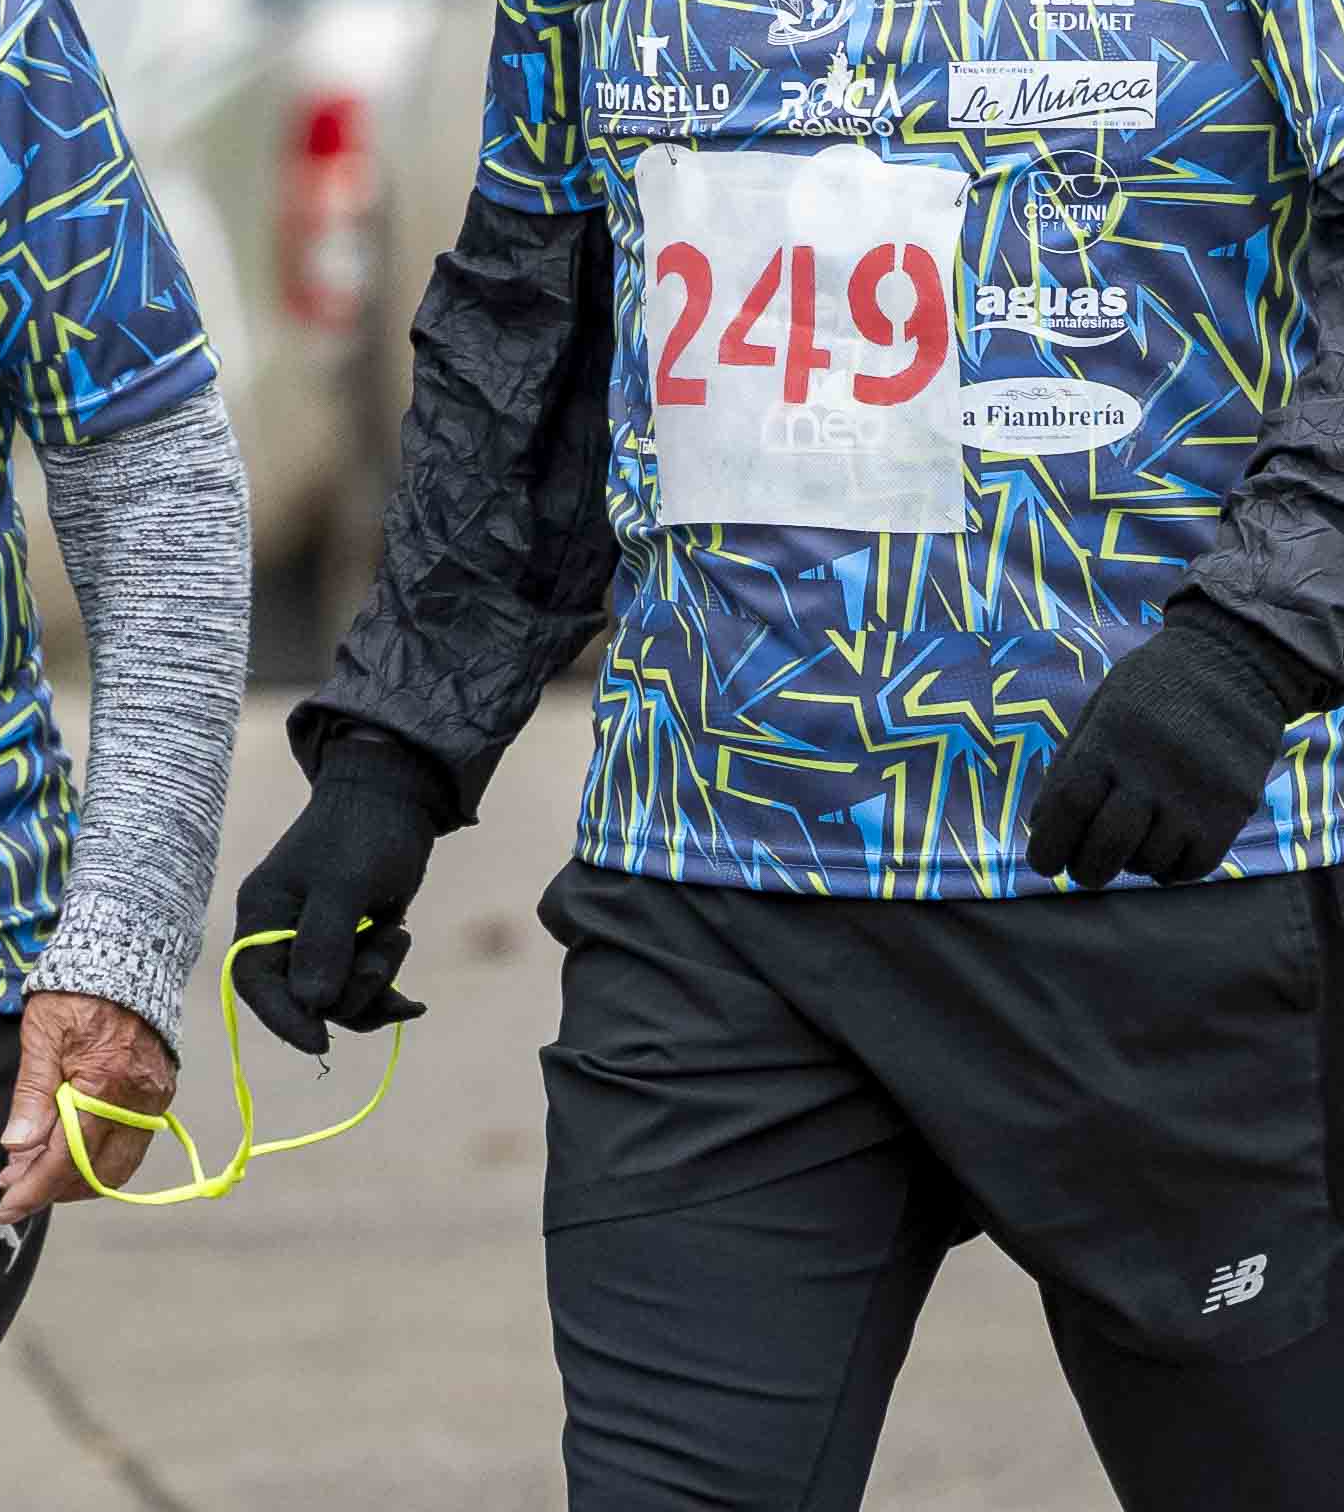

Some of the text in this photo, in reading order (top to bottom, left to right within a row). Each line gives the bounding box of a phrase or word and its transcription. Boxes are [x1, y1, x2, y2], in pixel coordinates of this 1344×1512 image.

[1028, 12, 1136, 31] CEDIMET
[595, 82, 730, 113] TOMASELLO
[951, 73, 1153, 123] La Muñeca
[788, 117, 894, 137] SONIDO
[1024, 203, 1107, 221] CONTINI
[975, 281, 1128, 325] aguas
[656, 241, 950, 406] 249
[1040, 316, 1126, 330] santafesinas
[987, 403, 1125, 427] Fiambrería
